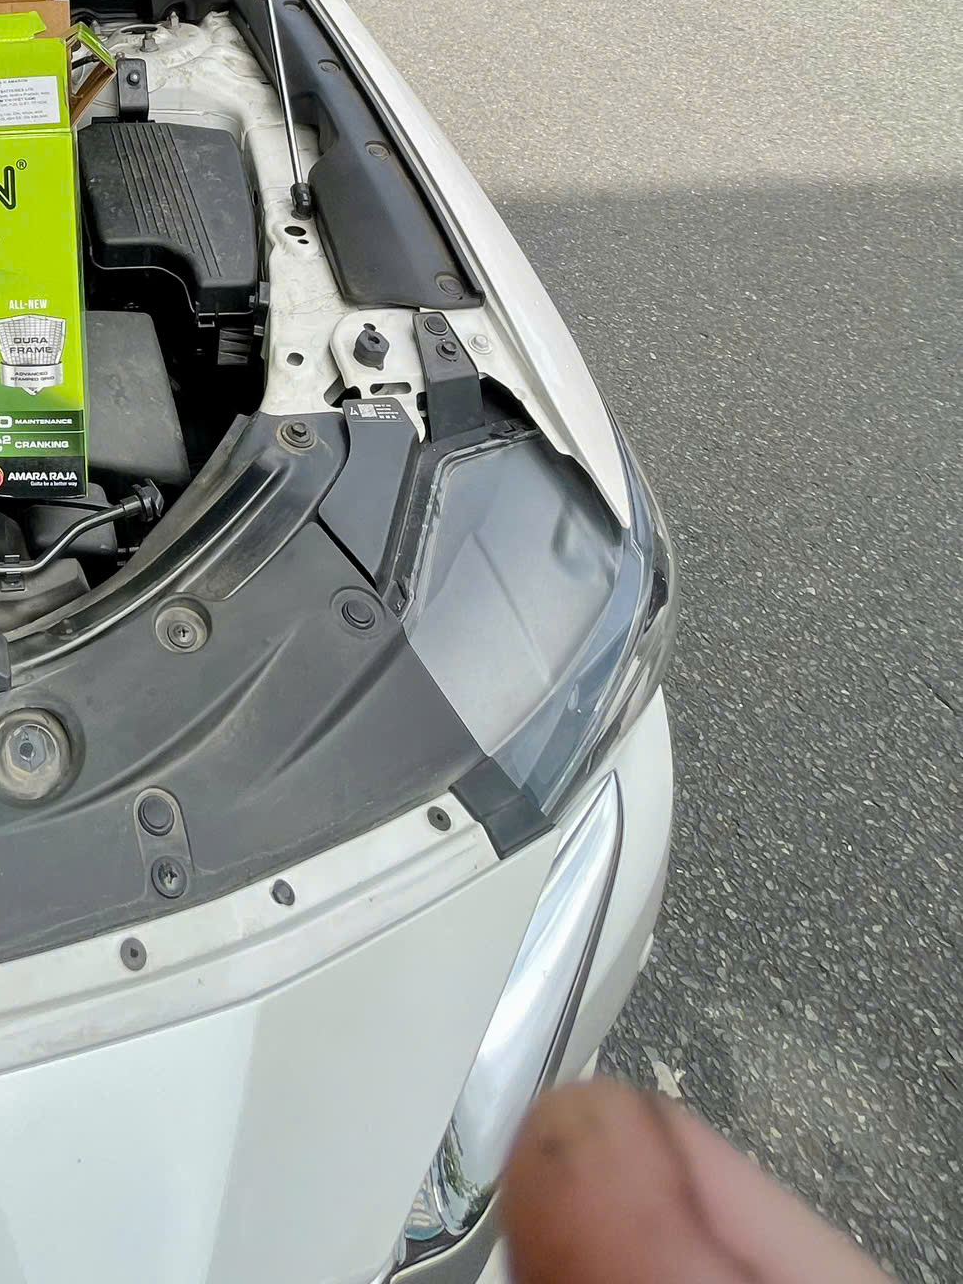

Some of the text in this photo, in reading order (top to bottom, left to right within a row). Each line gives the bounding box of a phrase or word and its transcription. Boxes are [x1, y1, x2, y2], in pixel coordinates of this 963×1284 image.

[9, 299, 48, 310] ALL-NEW
[9, 346, 53, 354] FRAME
[15, 441, 69, 449] CRANKING
[7, 471, 77, 481] AMARA RAJA
